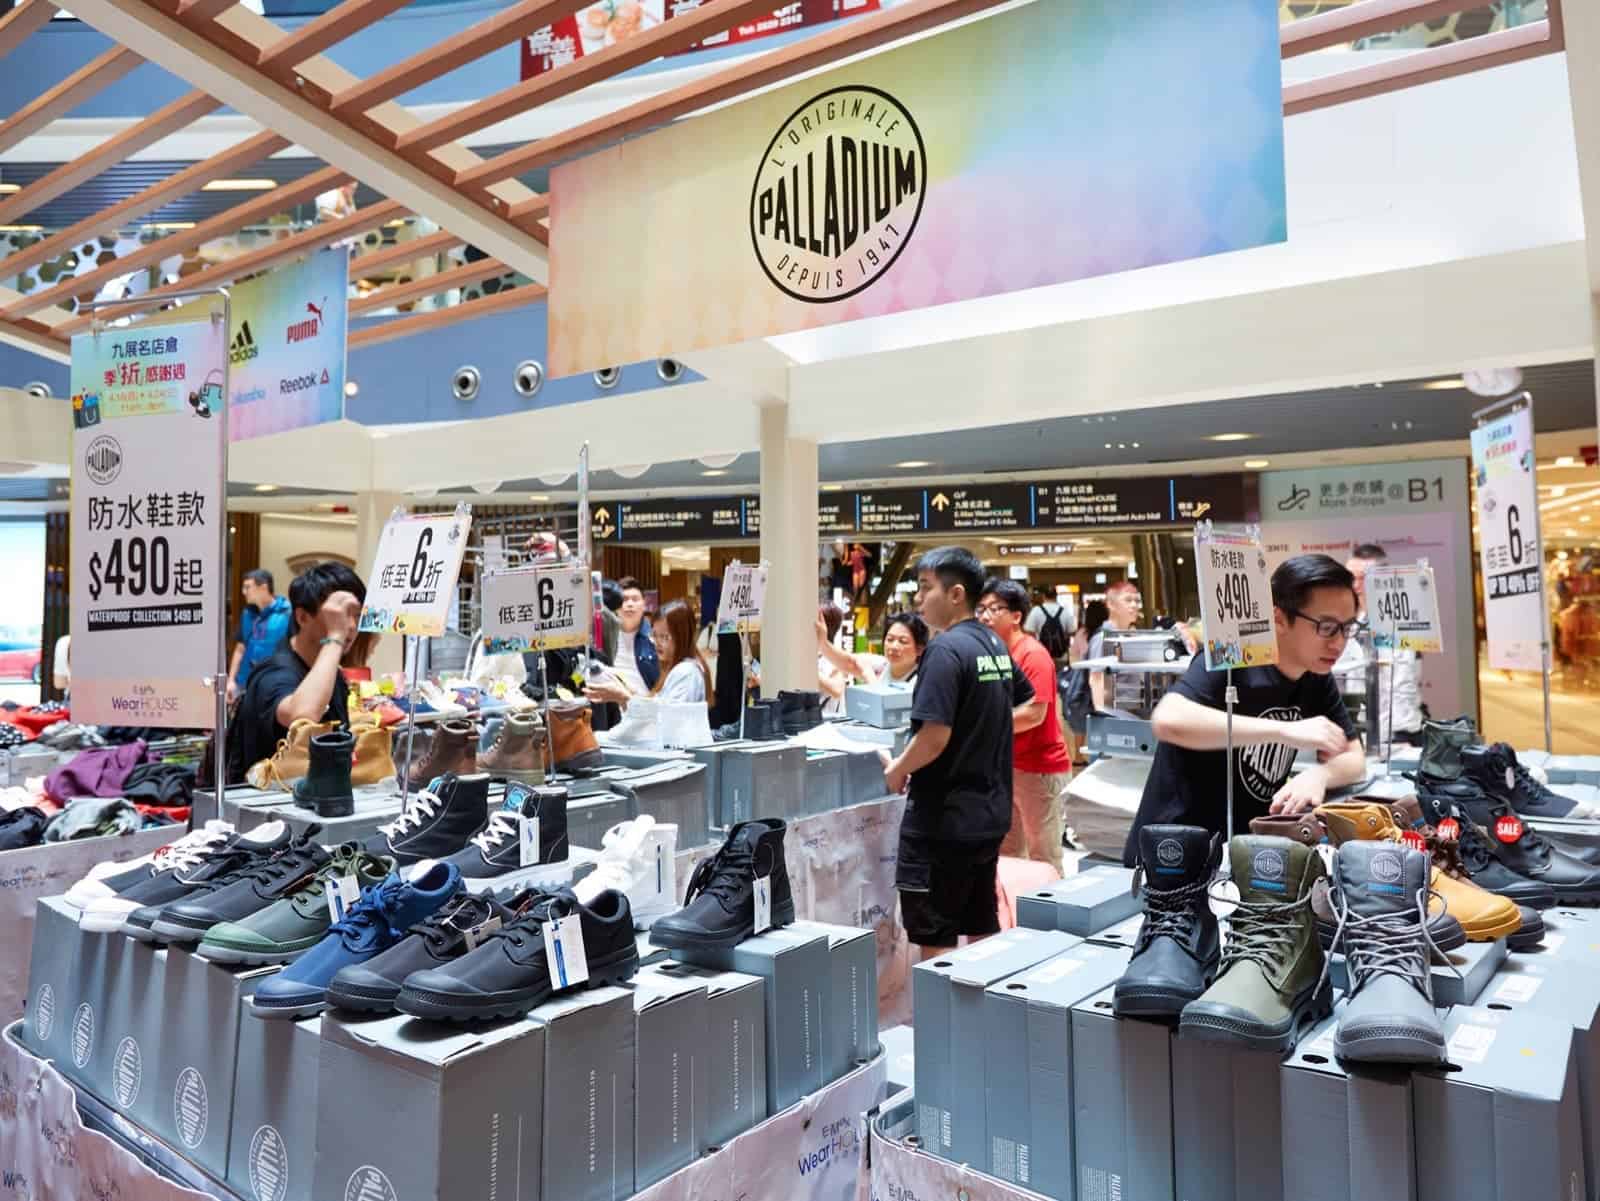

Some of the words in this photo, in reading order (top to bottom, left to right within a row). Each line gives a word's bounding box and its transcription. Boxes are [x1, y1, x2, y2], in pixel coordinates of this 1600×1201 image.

[772, 98, 900, 167] L'ORIGINALE
[759, 135, 917, 259] PALLADIUM
[777, 254, 844, 290] DEPUIS
[858, 223, 899, 275] 1947
[287, 319, 318, 344] PUMA
[280, 373, 317, 395] Reebok
[1319, 498, 1347, 508] More
[1350, 498, 1385, 508] Shops
[1408, 477, 1443, 503] B1
[88, 491, 205, 531] 防水鞋款
[88, 536, 204, 601] $490起
[380, 527, 444, 589] 低至6折
[1211, 549, 1246, 569] 防水鞋款
[89, 611, 130, 623] WATERPROOF
[132, 609, 171, 622] COLLECTION
[174, 608, 191, 621] $490
[499, 577, 575, 625] 低至6折
[112, 696, 179, 711] WearHOUSE
[1497, 823, 1519, 836] SALE
[118, 1041, 137, 1105] PALLADIUM
[180, 1071, 201, 1144] PALLADIUM
[943, 1111, 951, 1147] PALLADIUM
[1017, 1143, 1030, 1183] PALLADIUM
